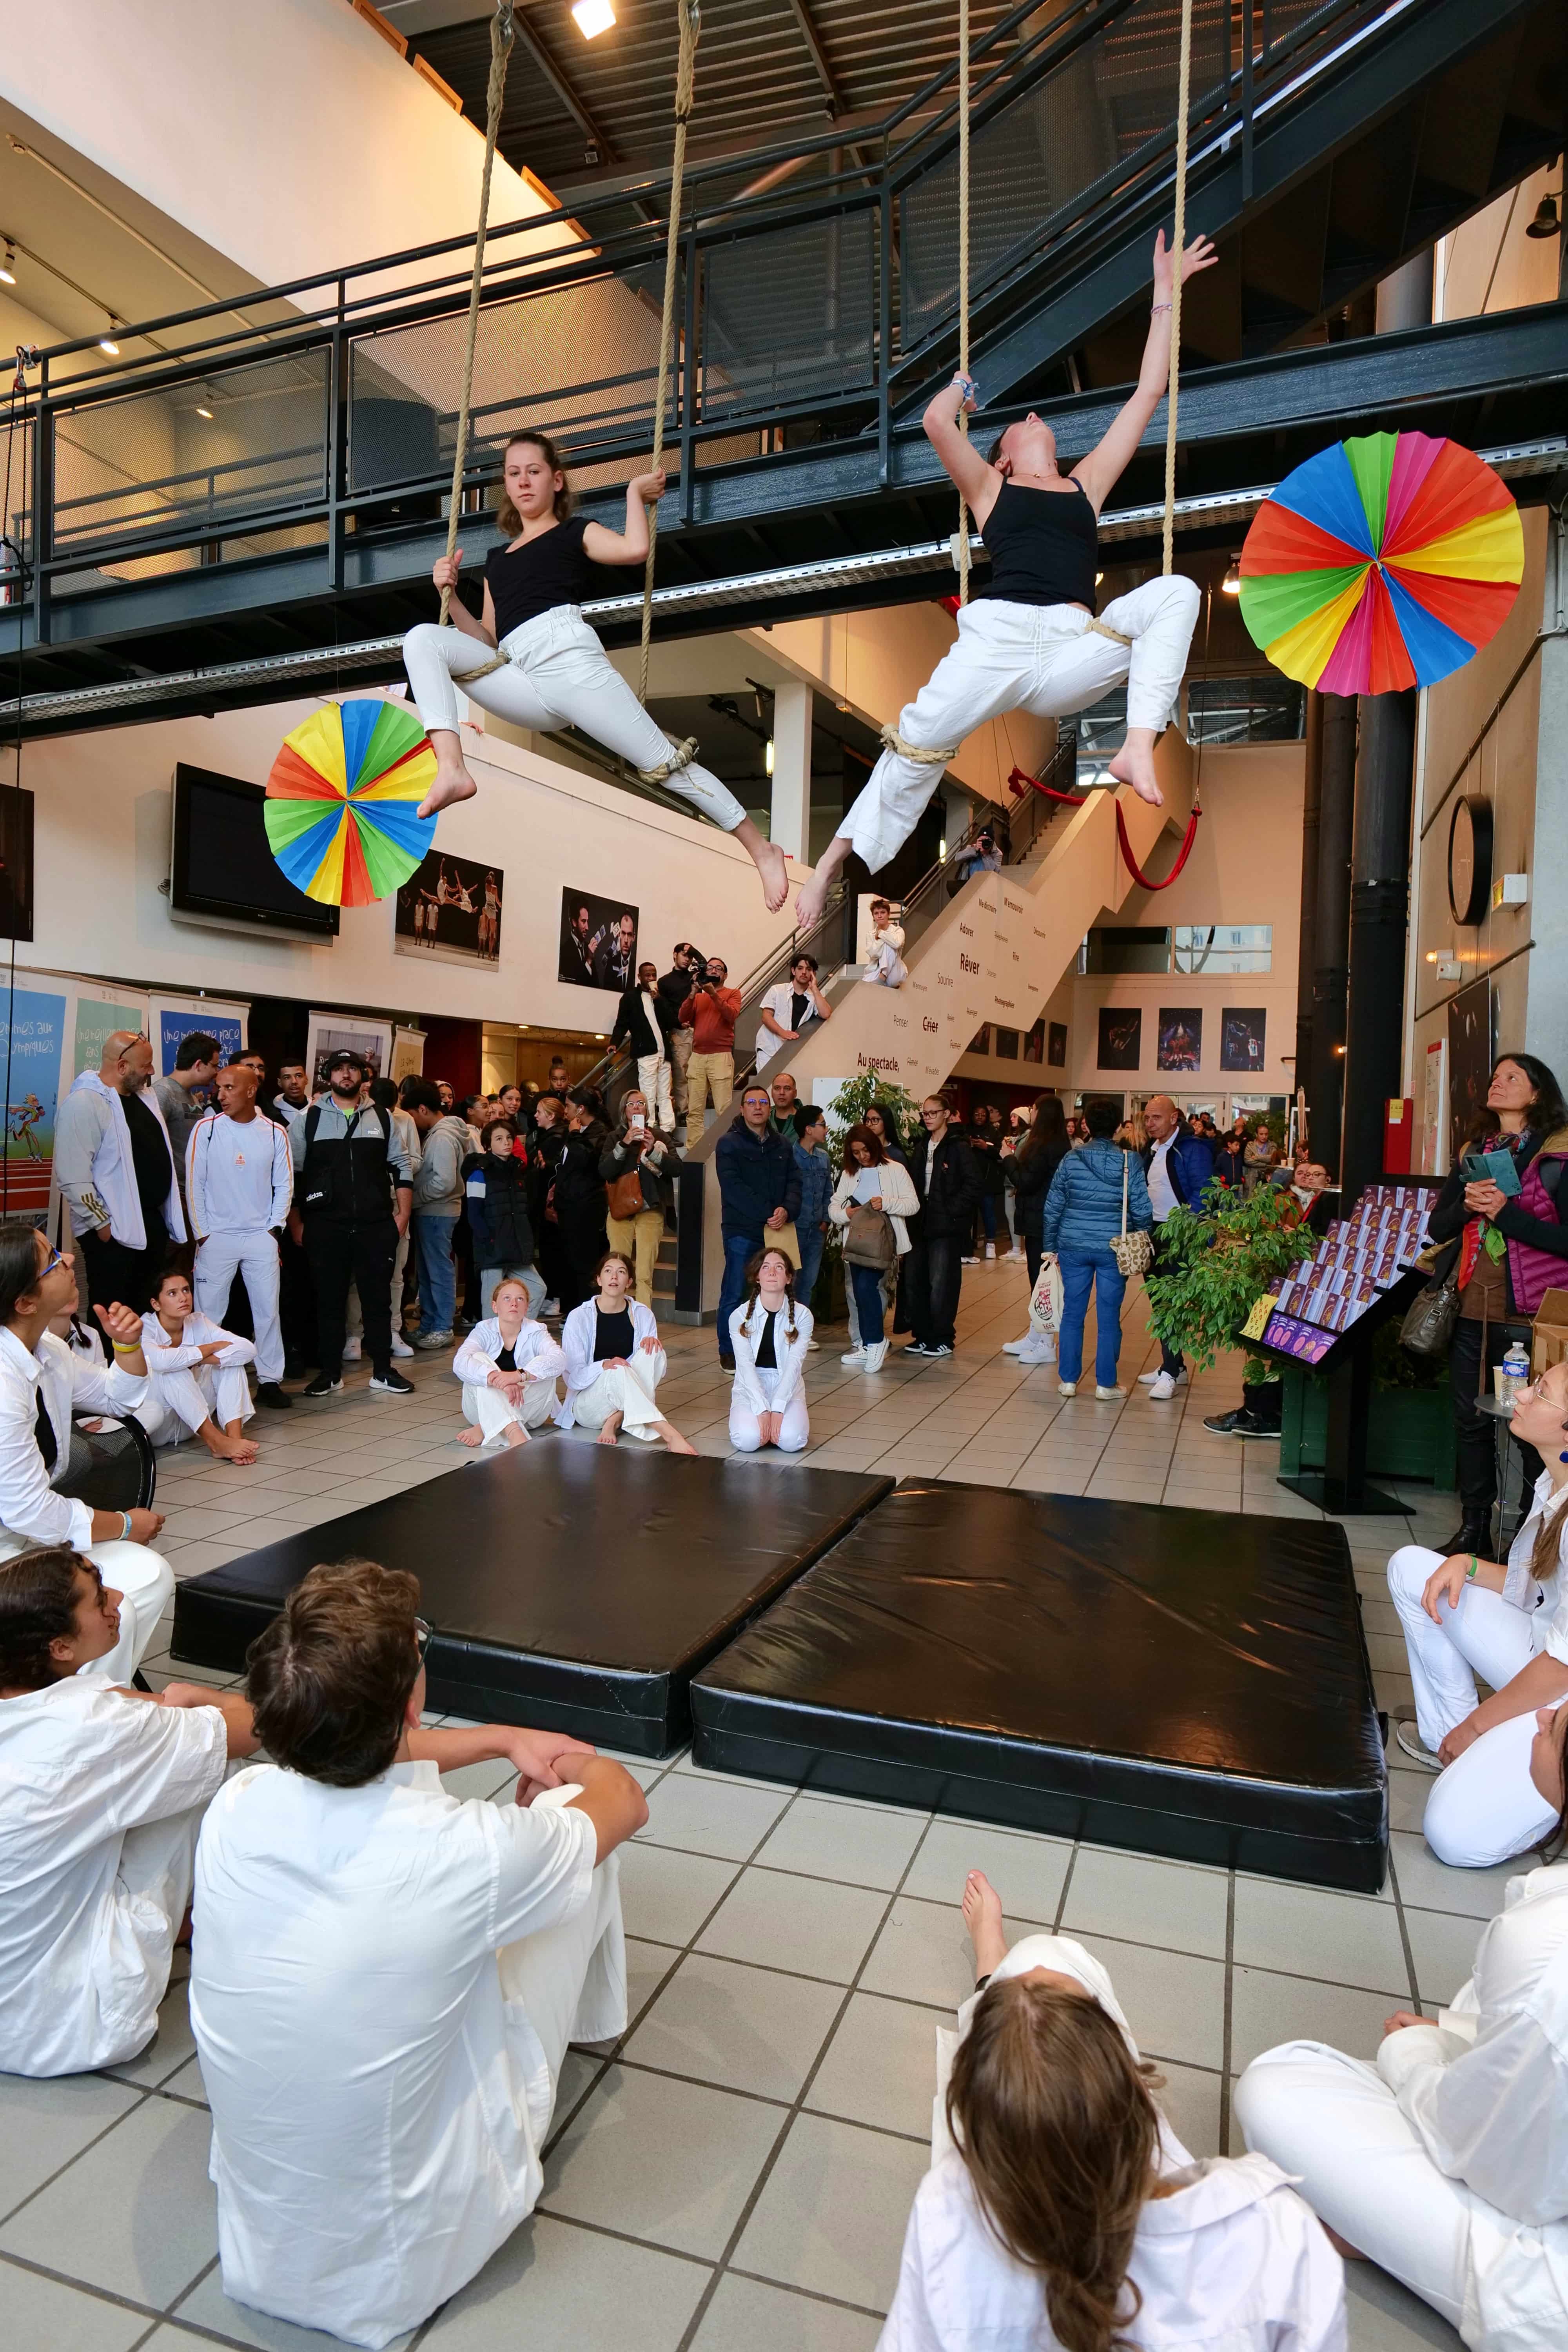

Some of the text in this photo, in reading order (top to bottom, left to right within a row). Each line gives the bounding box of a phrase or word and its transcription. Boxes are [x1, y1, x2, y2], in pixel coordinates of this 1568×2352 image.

[960, 922, 974, 937] Adorer
[960, 953, 980, 975] Rêver
[937, 972, 953, 987] Sourire
[36, 1022, 53, 1034] aux
[893, 1014, 908, 1027] Penser
[923, 1016, 938, 1033] Crier
[163, 1029, 179, 1044] Une
[219, 1029, 240, 1041] place
[857, 1052, 900, 1073] Au spectacle,
